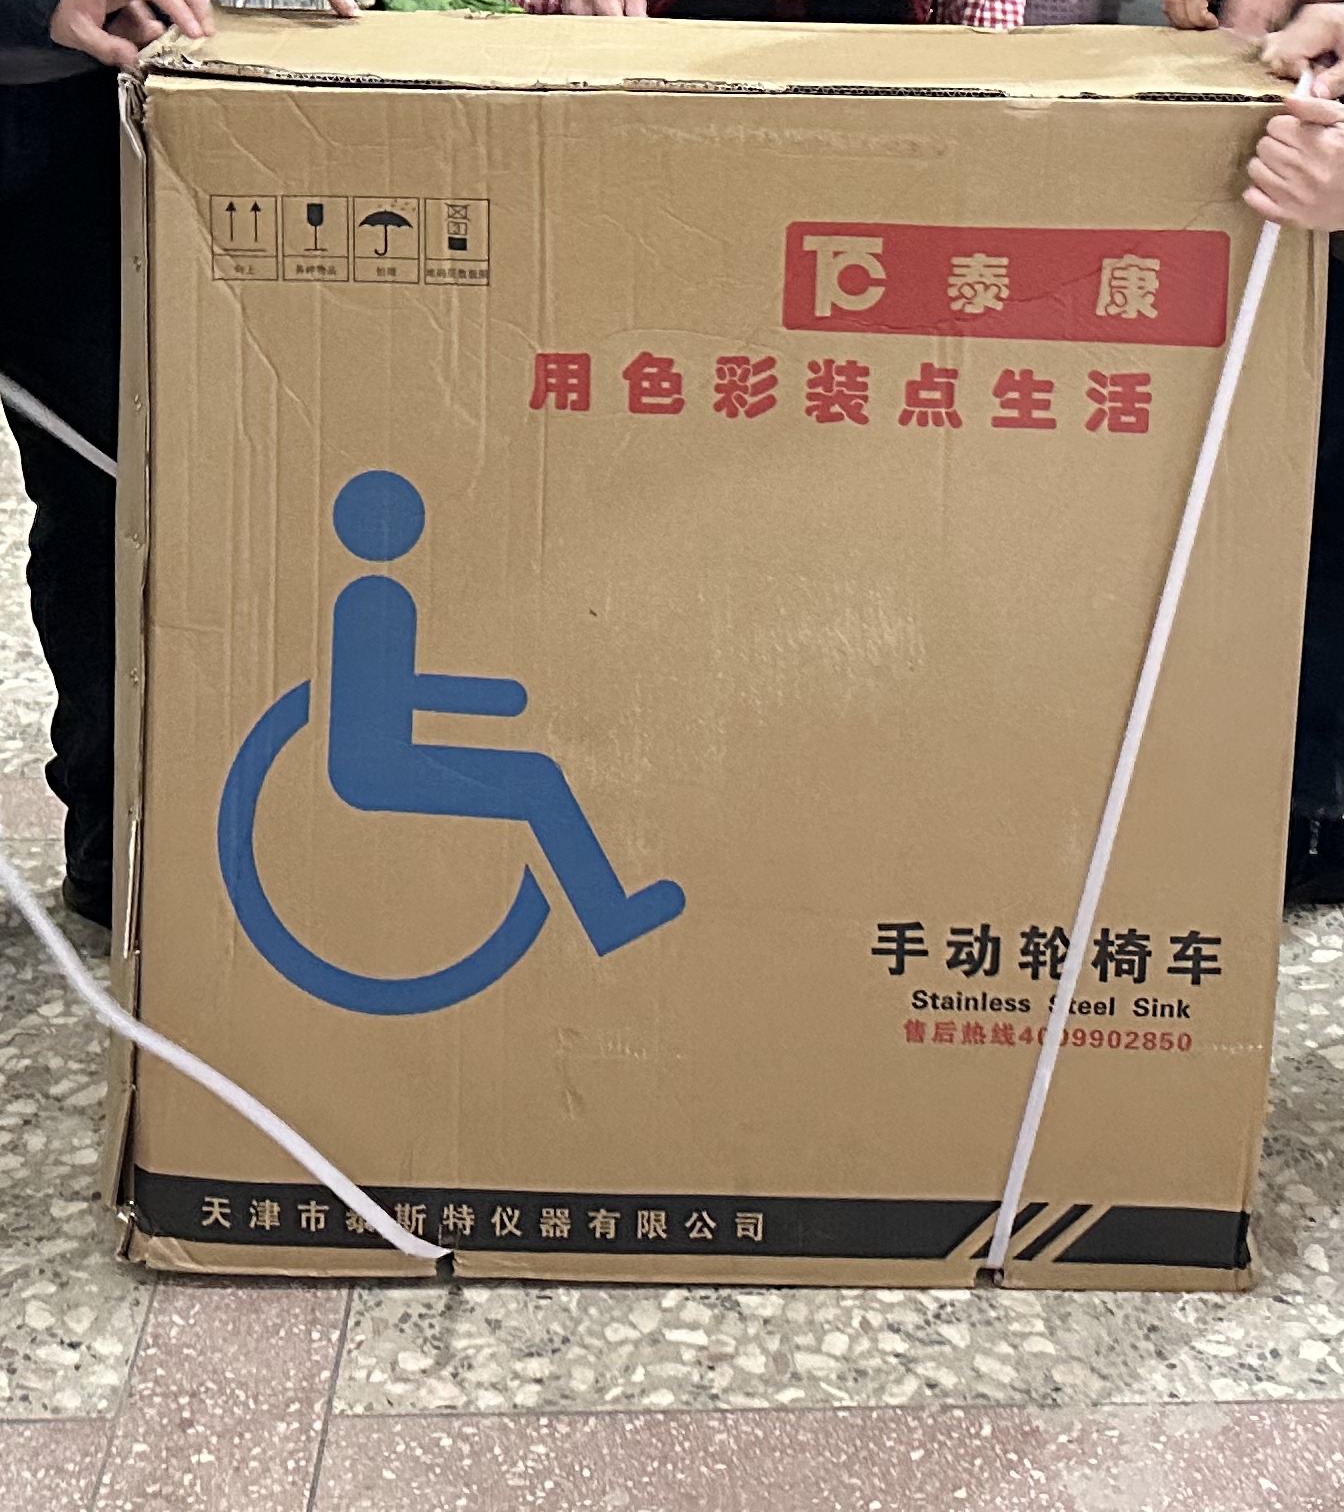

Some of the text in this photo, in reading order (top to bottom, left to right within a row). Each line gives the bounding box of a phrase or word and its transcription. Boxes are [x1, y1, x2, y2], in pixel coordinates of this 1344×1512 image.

[947, 252, 1161, 319] 泰康
[529, 352, 1153, 434] 用色彩装点生活
[871, 921, 1223, 986] 手动轮椅车
[911, 989, 1032, 1013] Stainless
[1132, 997, 1192, 1019] Sink
